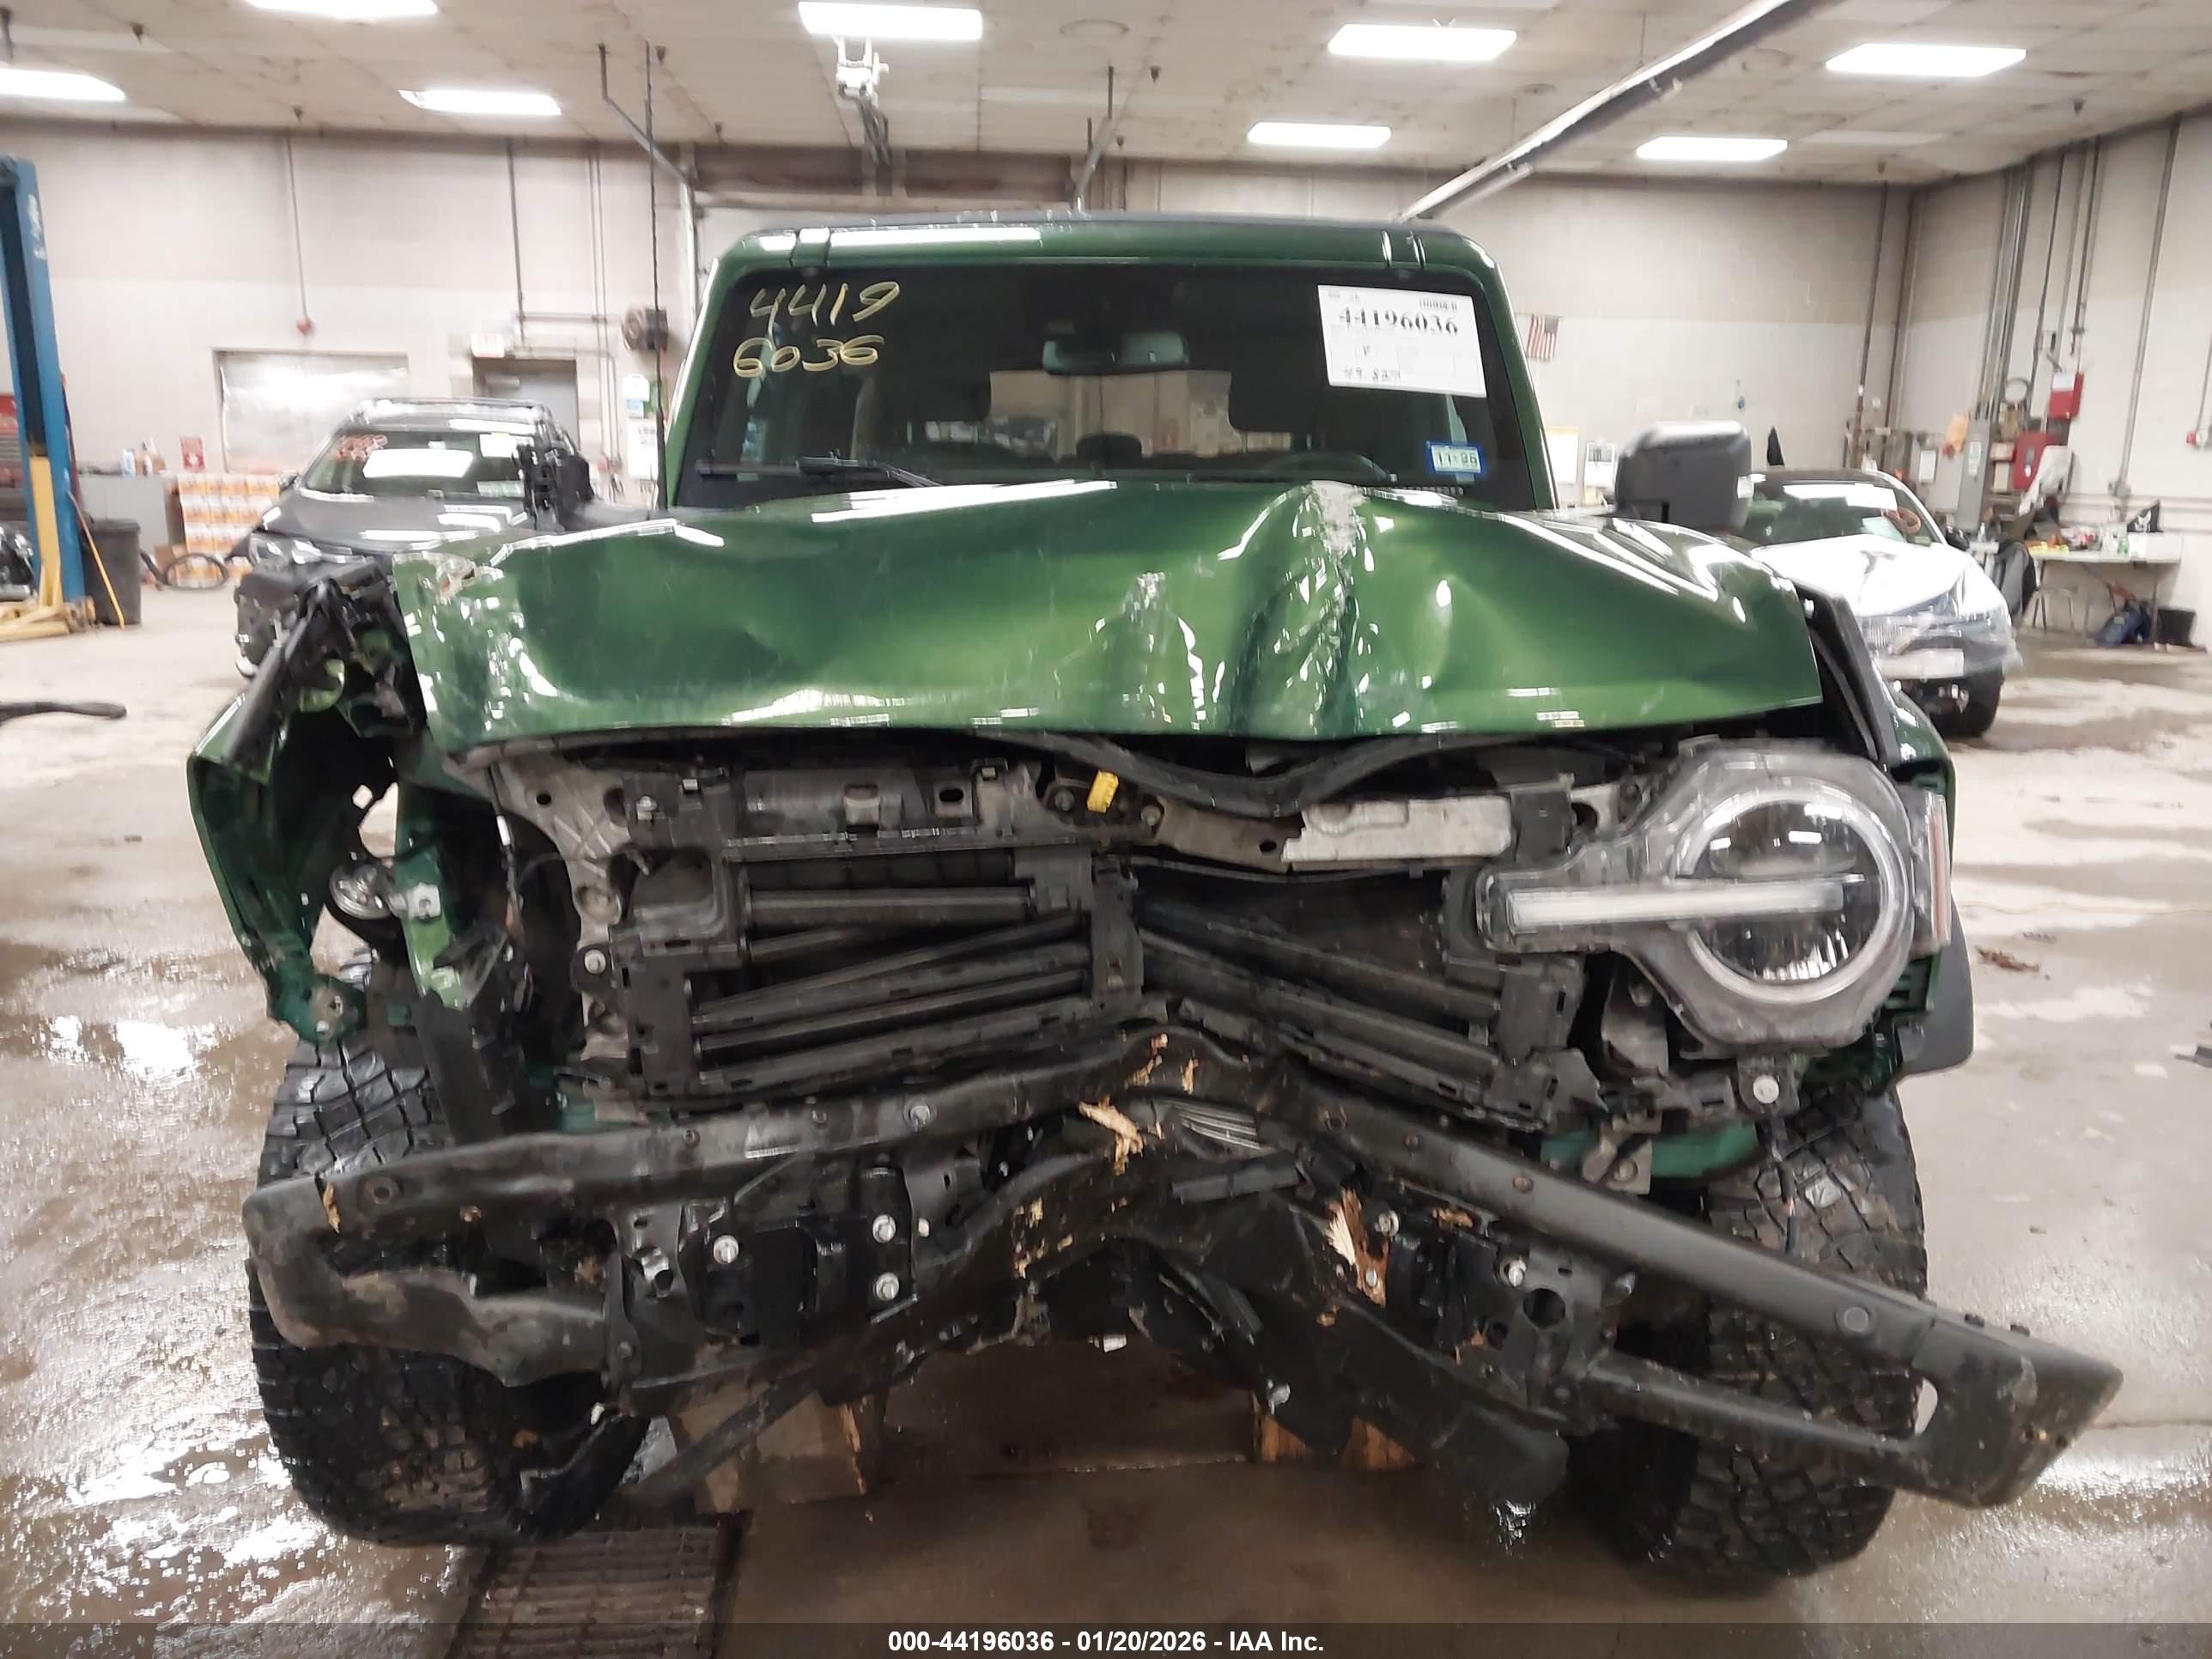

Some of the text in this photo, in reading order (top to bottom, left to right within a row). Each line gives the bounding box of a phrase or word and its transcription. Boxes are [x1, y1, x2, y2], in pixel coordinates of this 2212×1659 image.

[750, 281, 901, 338] 4419
[1339, 306, 1459, 337] 44196036
[732, 334, 885, 378] 6036
